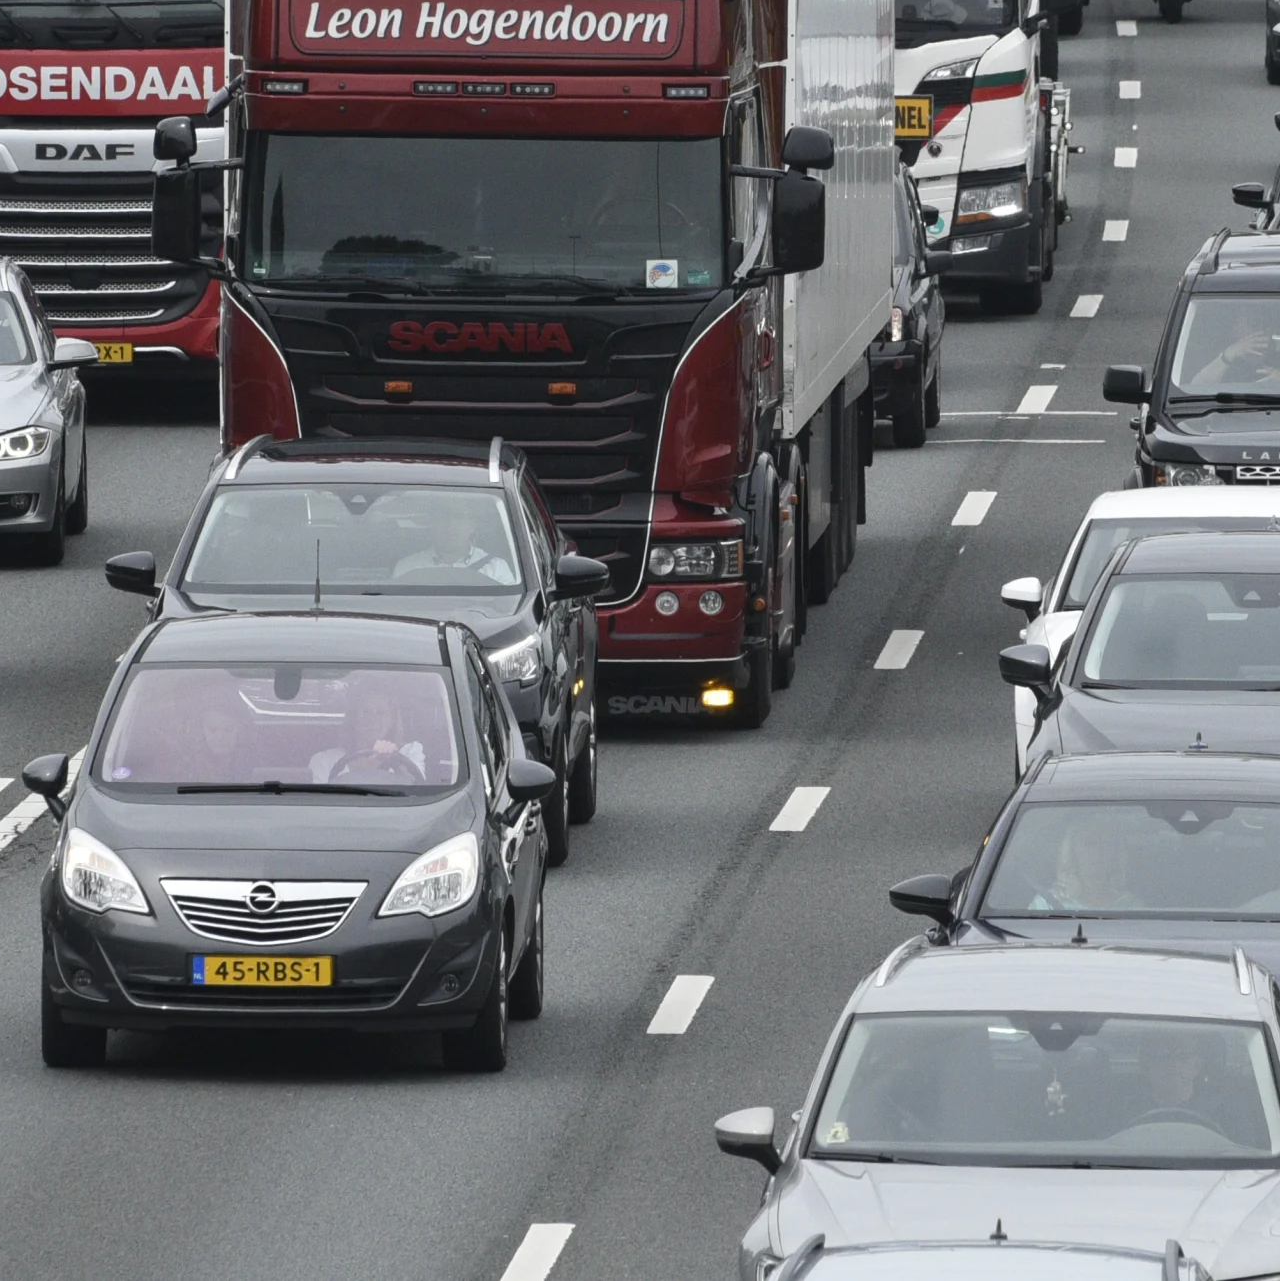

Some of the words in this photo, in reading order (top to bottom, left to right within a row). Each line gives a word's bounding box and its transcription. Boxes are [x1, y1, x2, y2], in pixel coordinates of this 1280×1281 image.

[305, 2, 403, 39] Leon
[415, 2, 669, 46] Hogendoorn
[35, 143, 136, 161] DAF
[388, 320, 574, 354] SCANIA
[607, 694, 714, 715] SCANIA
[215, 959, 322, 982] 45-RBS-1
